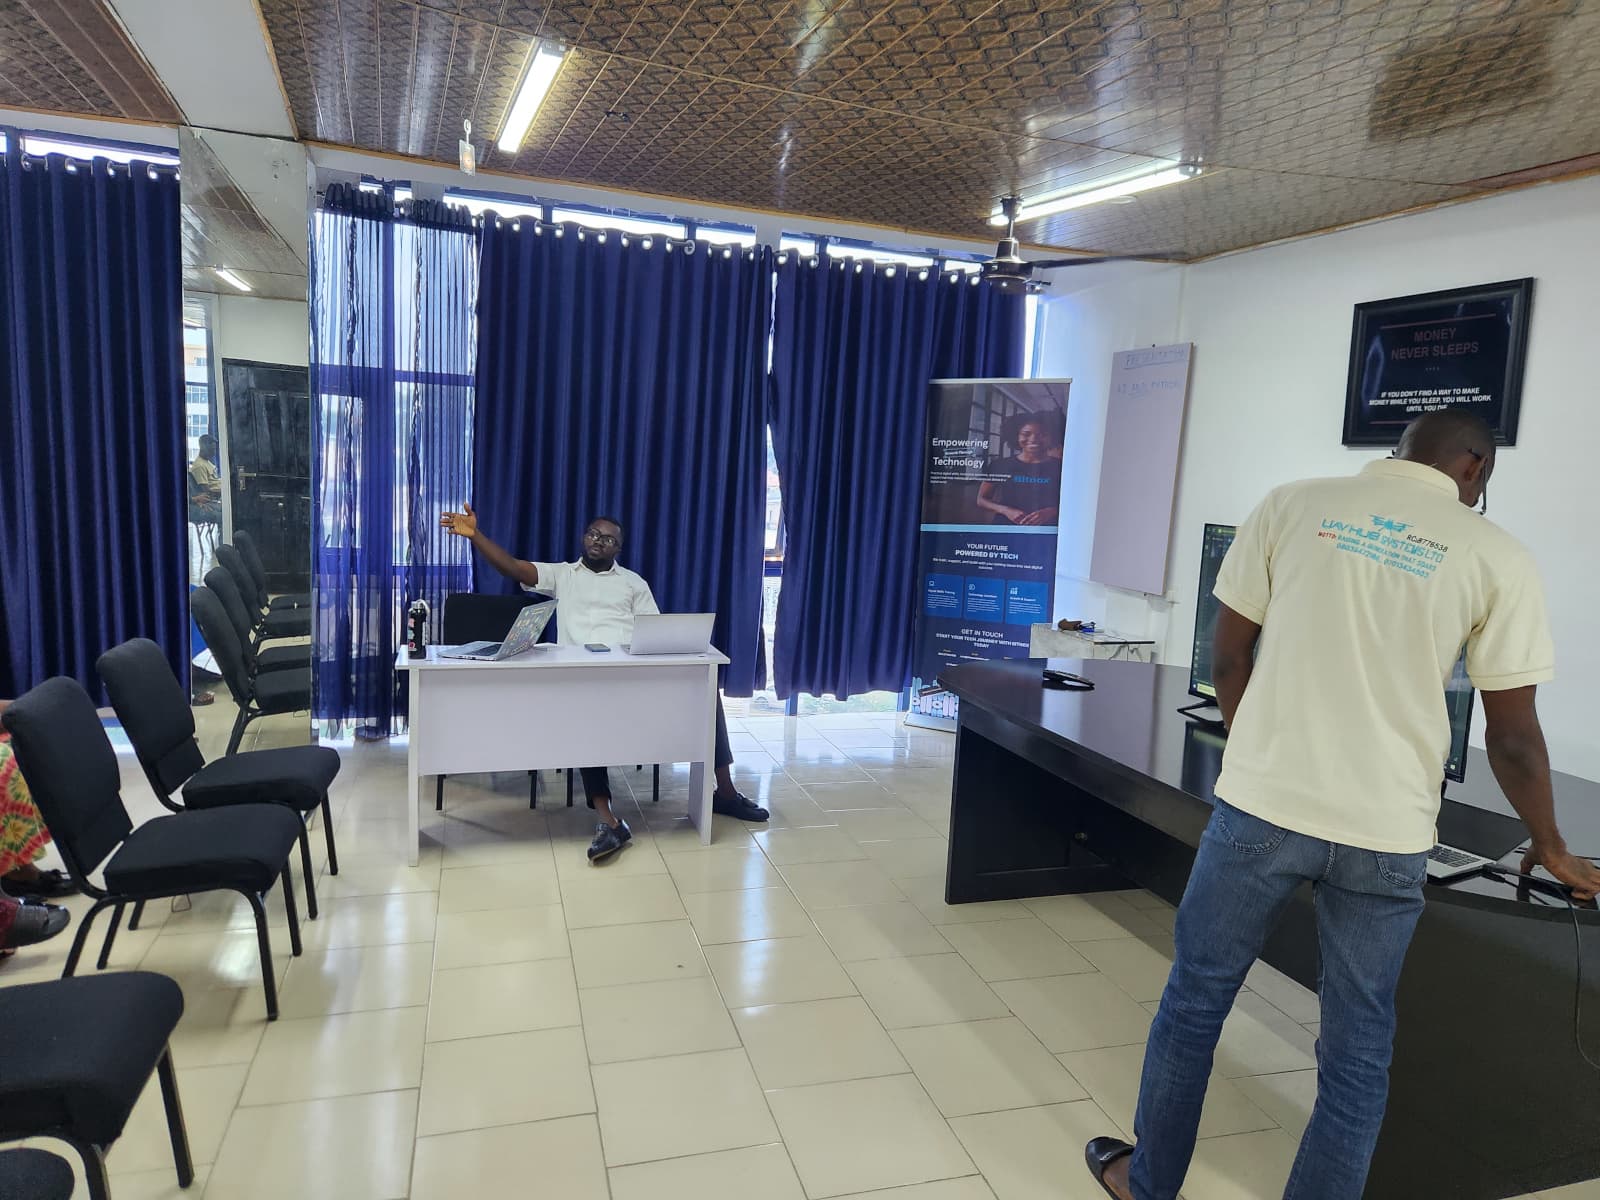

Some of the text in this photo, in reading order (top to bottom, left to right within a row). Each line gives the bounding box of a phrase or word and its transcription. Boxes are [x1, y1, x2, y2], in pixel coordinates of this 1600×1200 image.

[1414, 328, 1456, 342] MONEY
[1392, 342, 1479, 360] NEVER SLEEPS
[1419, 389, 1432, 397] FIND
[1461, 387, 1480, 395] MAKE
[1390, 397, 1408, 405] WHILE
[1456, 395, 1471, 403] WILL
[1472, 394, 1492, 402] WORK
[932, 438, 989, 450] Empowering
[933, 457, 985, 469] Technology
[1349, 525, 1380, 541] HUB
[1381, 535, 1426, 556] SYSTEMS
[1425, 549, 1445, 563] LTD
[955, 549, 988, 558] POWERED
[981, 630, 1004, 638] TOUCH
